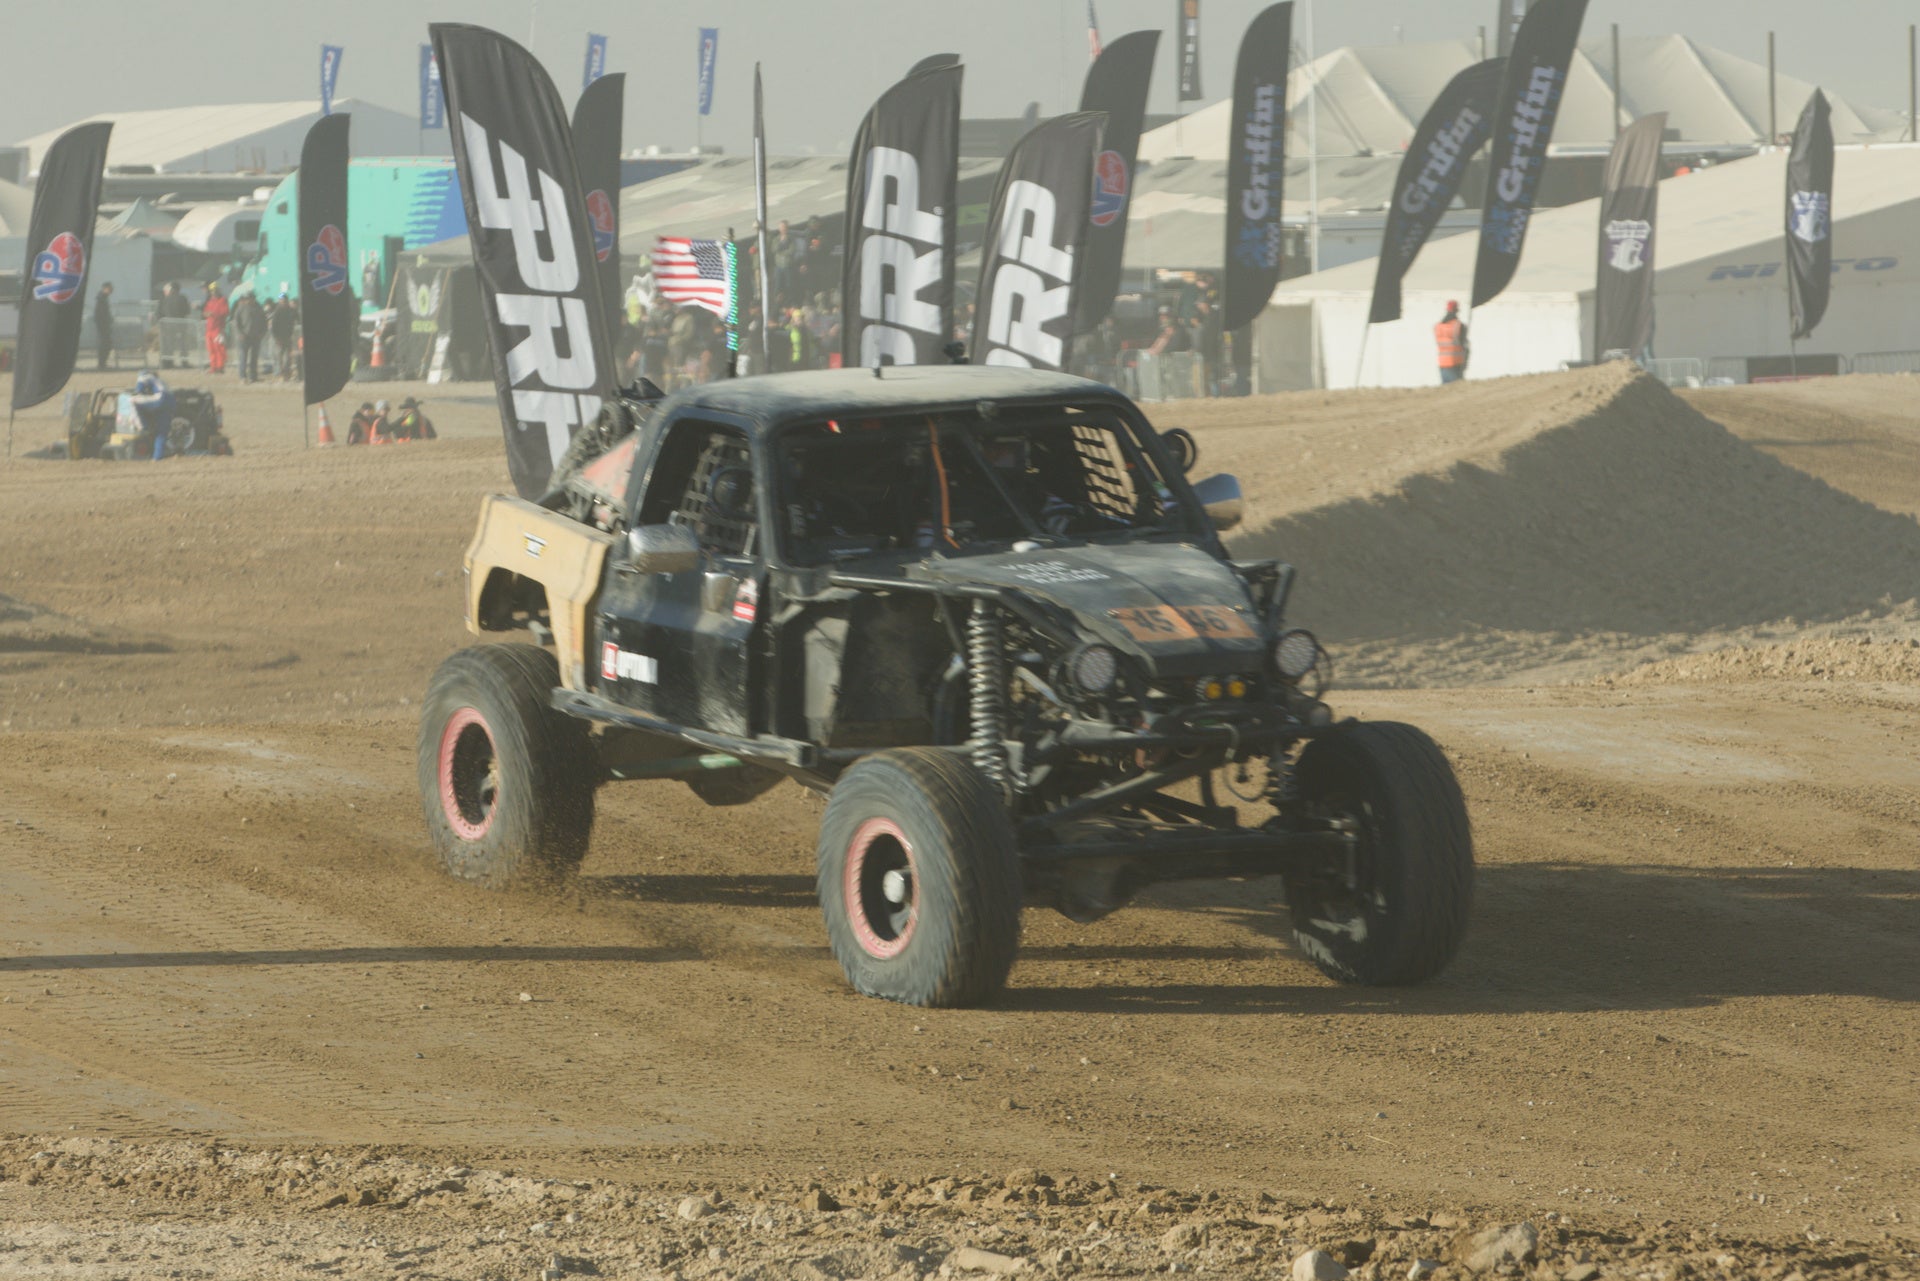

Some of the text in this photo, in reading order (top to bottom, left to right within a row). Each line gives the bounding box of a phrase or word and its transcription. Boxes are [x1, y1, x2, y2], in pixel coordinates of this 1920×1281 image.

[1242, 83, 1276, 220] Griffin
[1400, 106, 1482, 215] Griffin
[1497, 65, 1556, 203] Griffin
[32, 250, 82, 300] VP
[307, 242, 346, 292] VP
[1707, 256, 1898, 281] NITO
